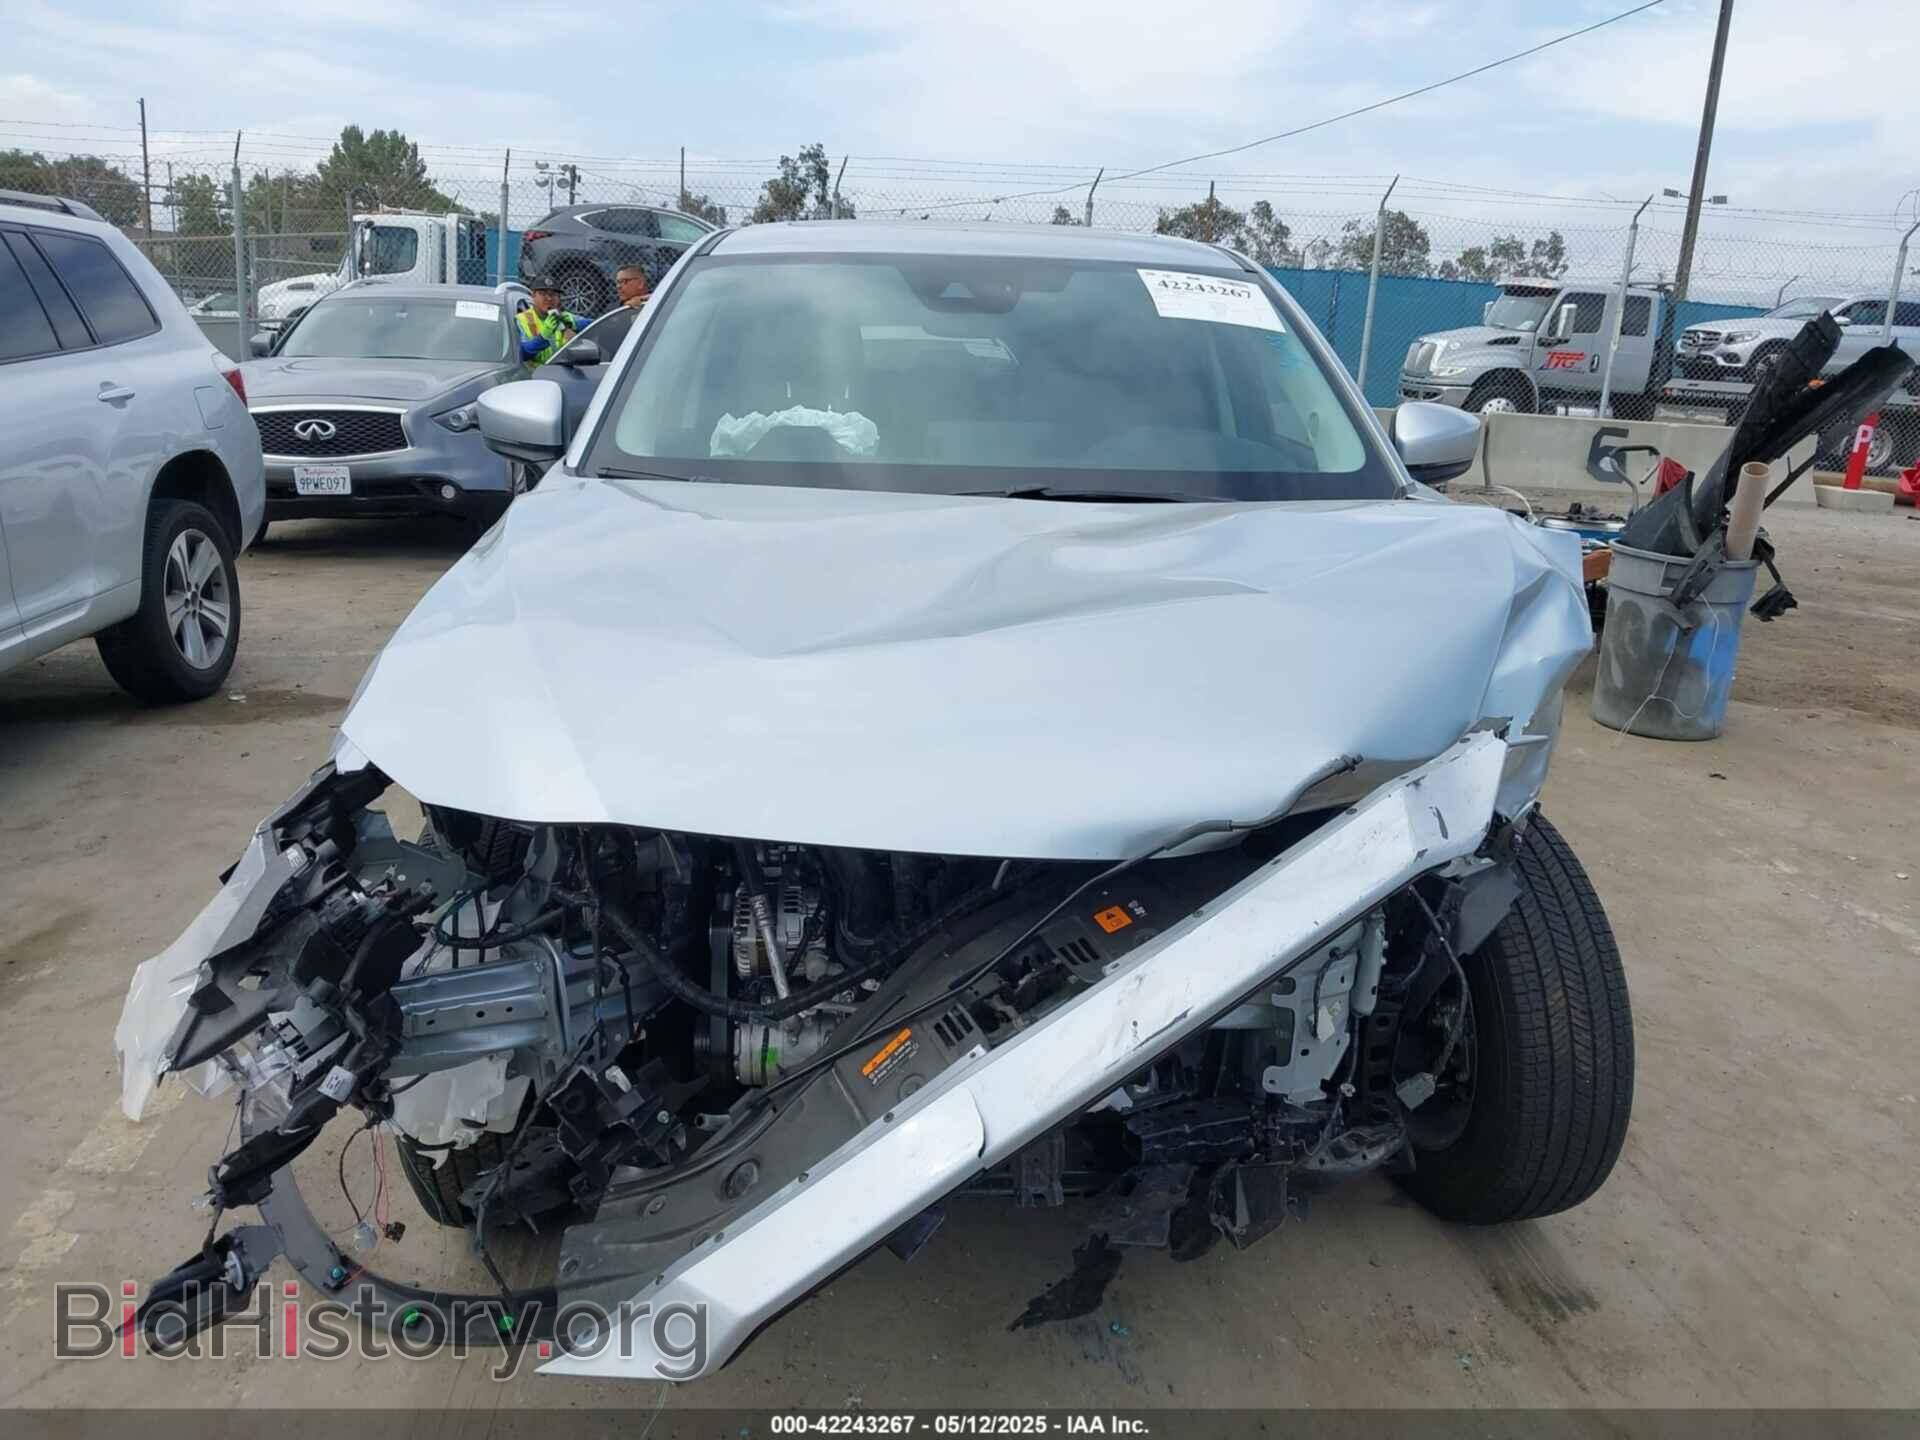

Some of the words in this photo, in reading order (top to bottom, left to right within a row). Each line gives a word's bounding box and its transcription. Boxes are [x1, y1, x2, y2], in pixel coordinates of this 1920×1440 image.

[1158, 279, 1251, 299] 42243267
[1853, 424, 1874, 453] P
[1586, 427, 1629, 484] 6
[299, 476, 346, 491] 9PWE097
